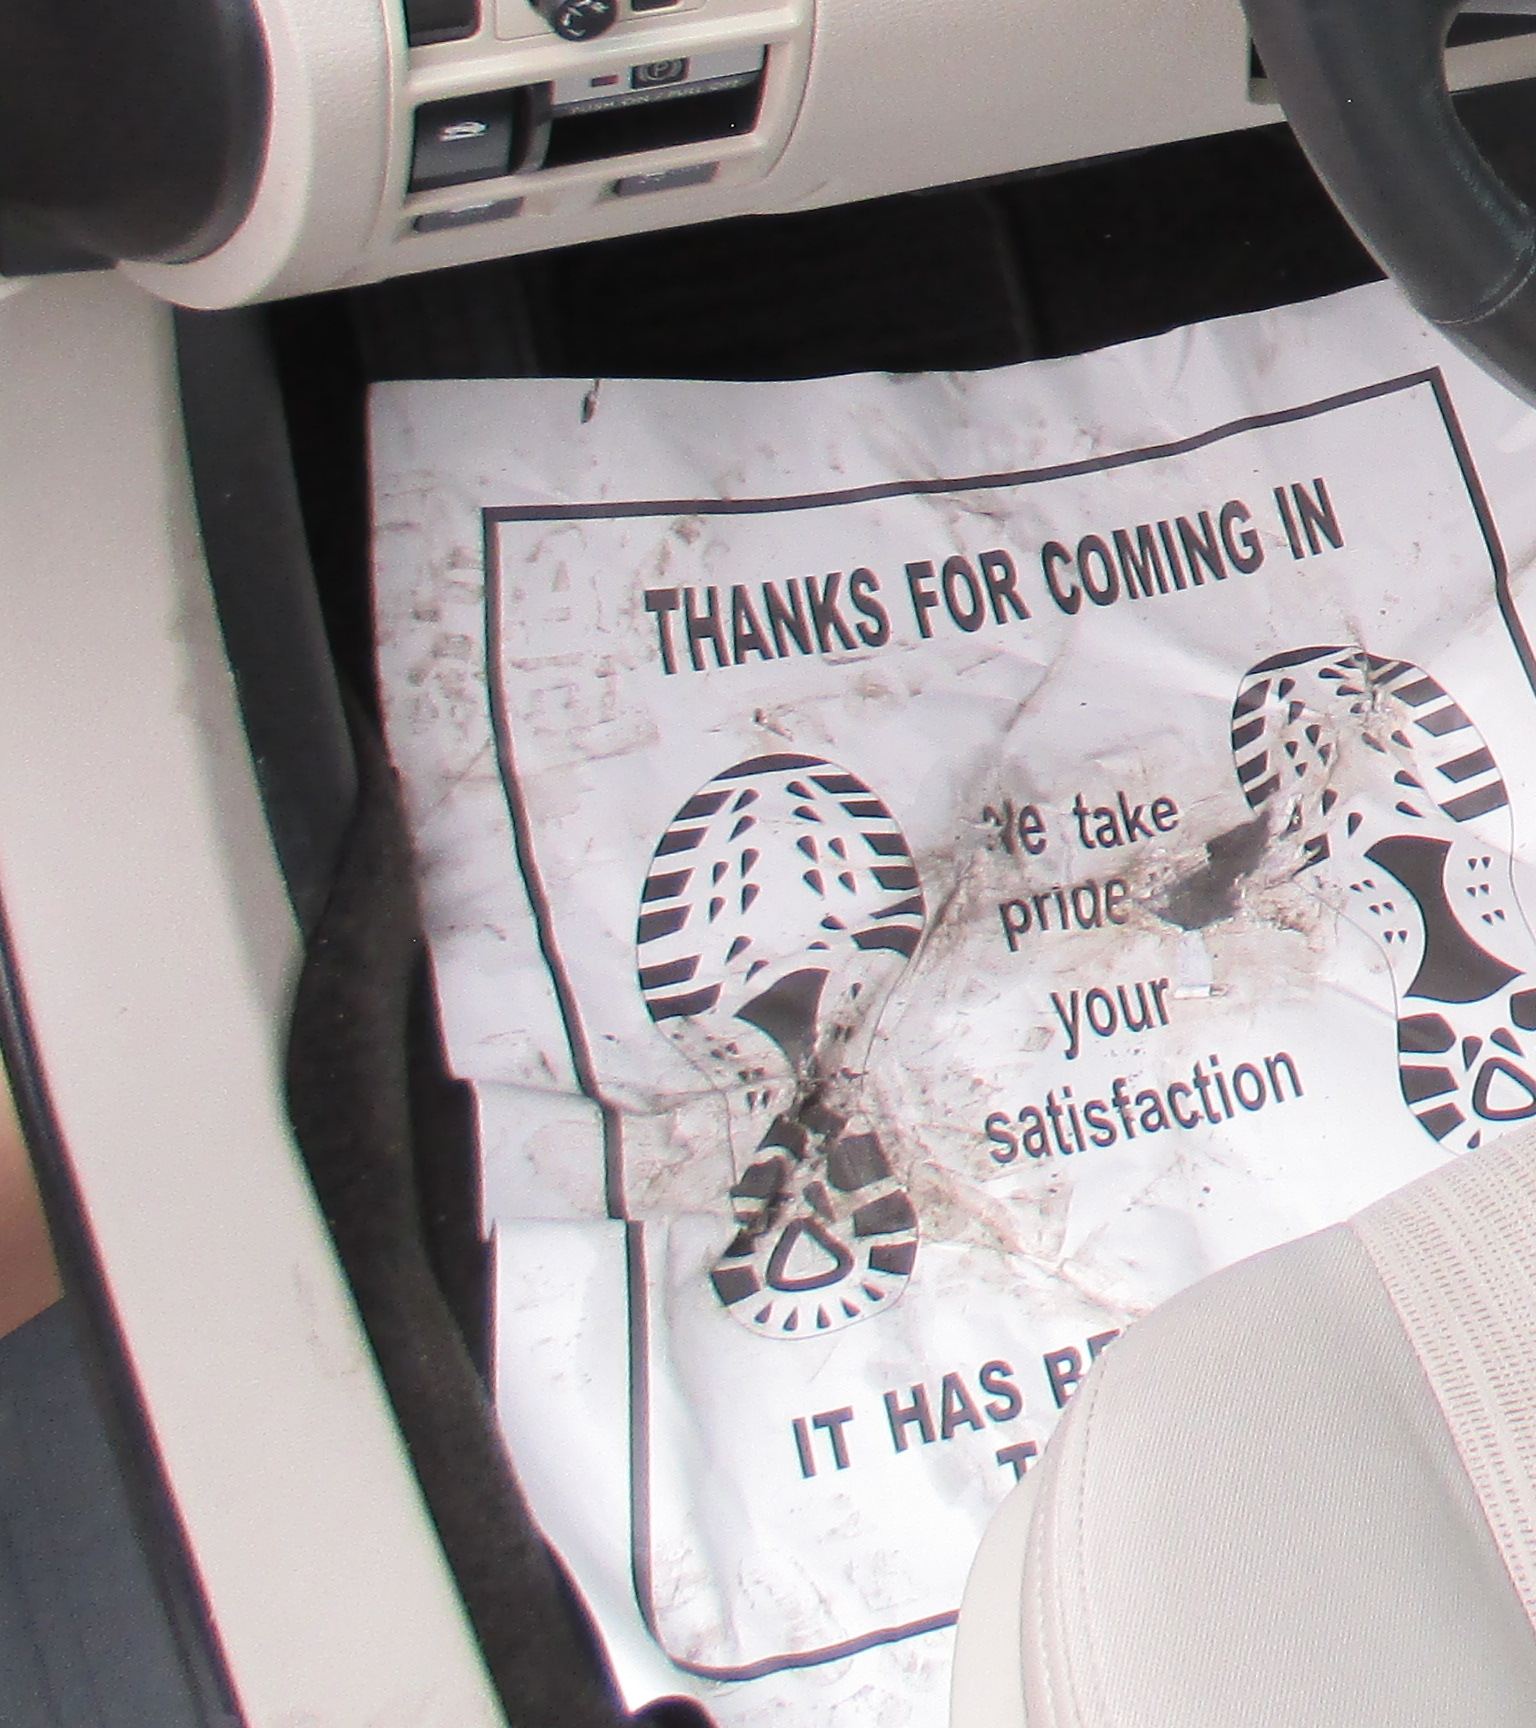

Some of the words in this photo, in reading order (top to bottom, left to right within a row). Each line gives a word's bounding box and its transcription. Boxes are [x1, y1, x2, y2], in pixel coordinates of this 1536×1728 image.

[643, 567, 892, 676] THANKS
[905, 548, 1033, 640] FOR
[1040, 499, 1268, 616] COMING
[1272, 477, 1346, 561] IN
[1071, 789, 1181, 850] take
[998, 876, 1131, 953] pride
[1048, 976, 1171, 1061] your
[984, 1049, 1306, 1165] satisfaction
[791, 1405, 855, 1480] IT
[882, 1358, 1024, 1454] HAS
[995, 1439, 1039, 1485] T
